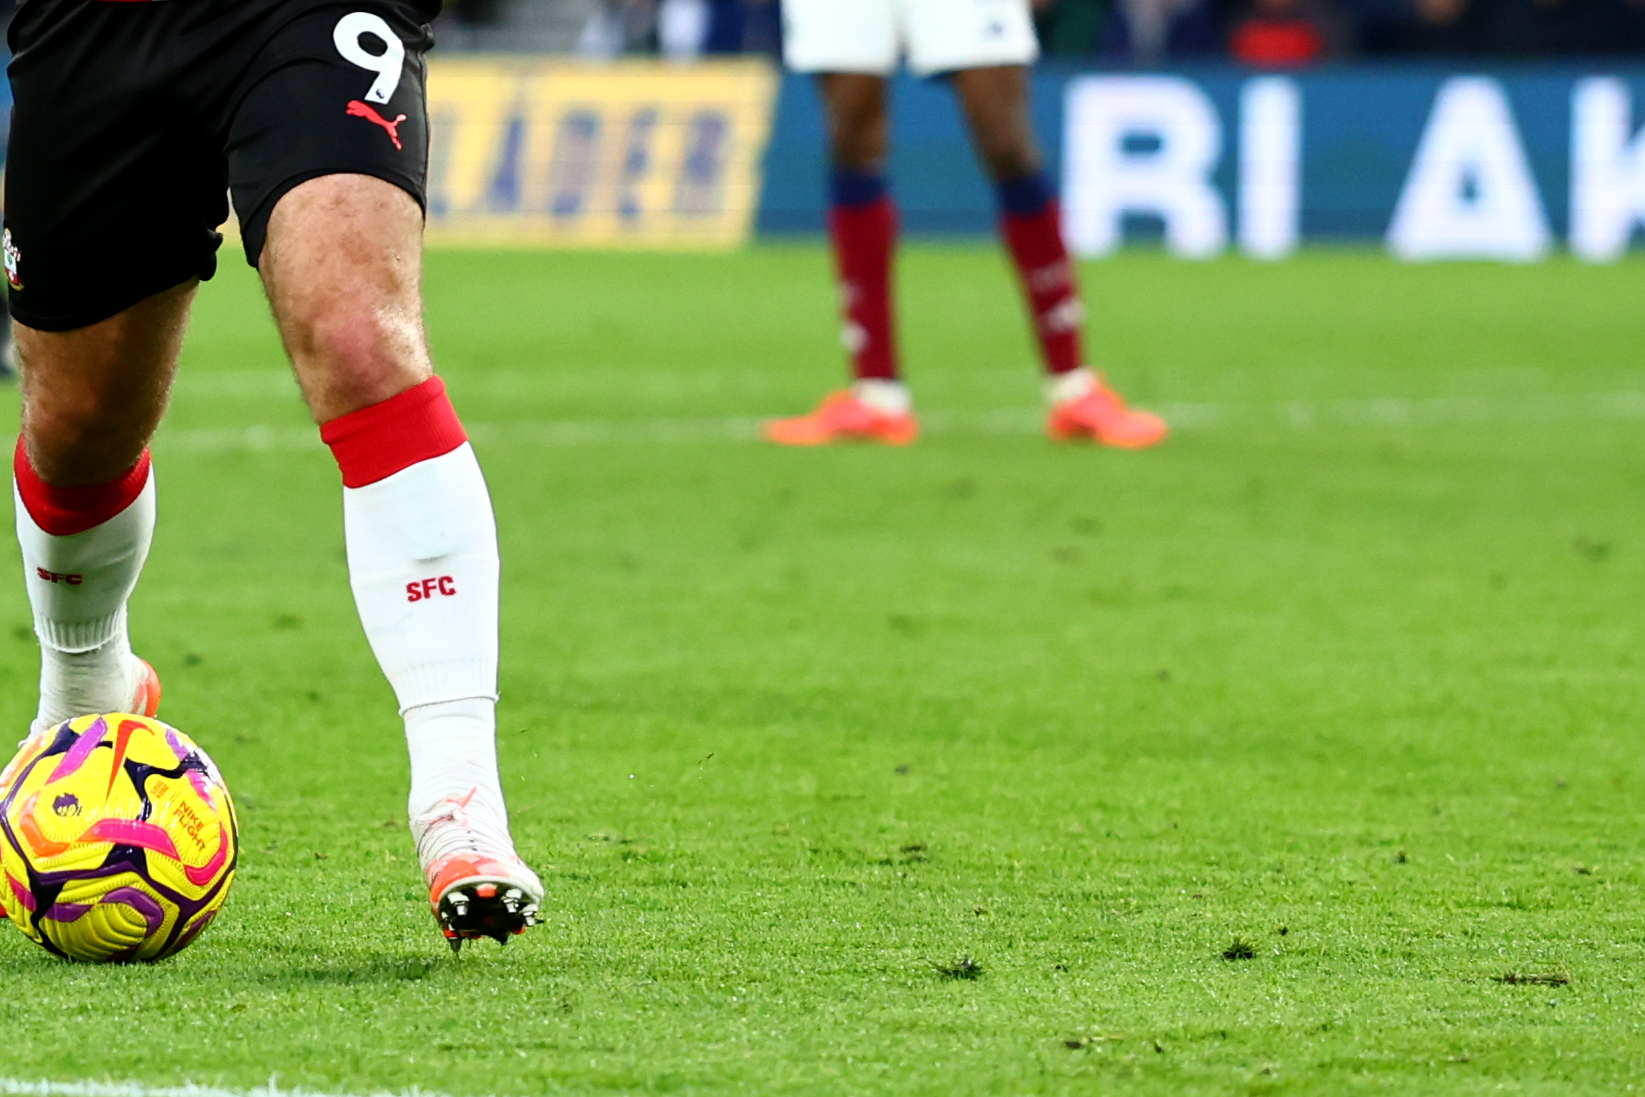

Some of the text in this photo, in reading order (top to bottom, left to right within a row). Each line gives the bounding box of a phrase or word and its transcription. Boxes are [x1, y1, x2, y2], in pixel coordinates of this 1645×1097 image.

[333, 12, 405, 104] 9
[406, 575, 457, 603] SFC
[172, 808, 206, 852] FLIGHT
[179, 800, 204, 832] NIKE
